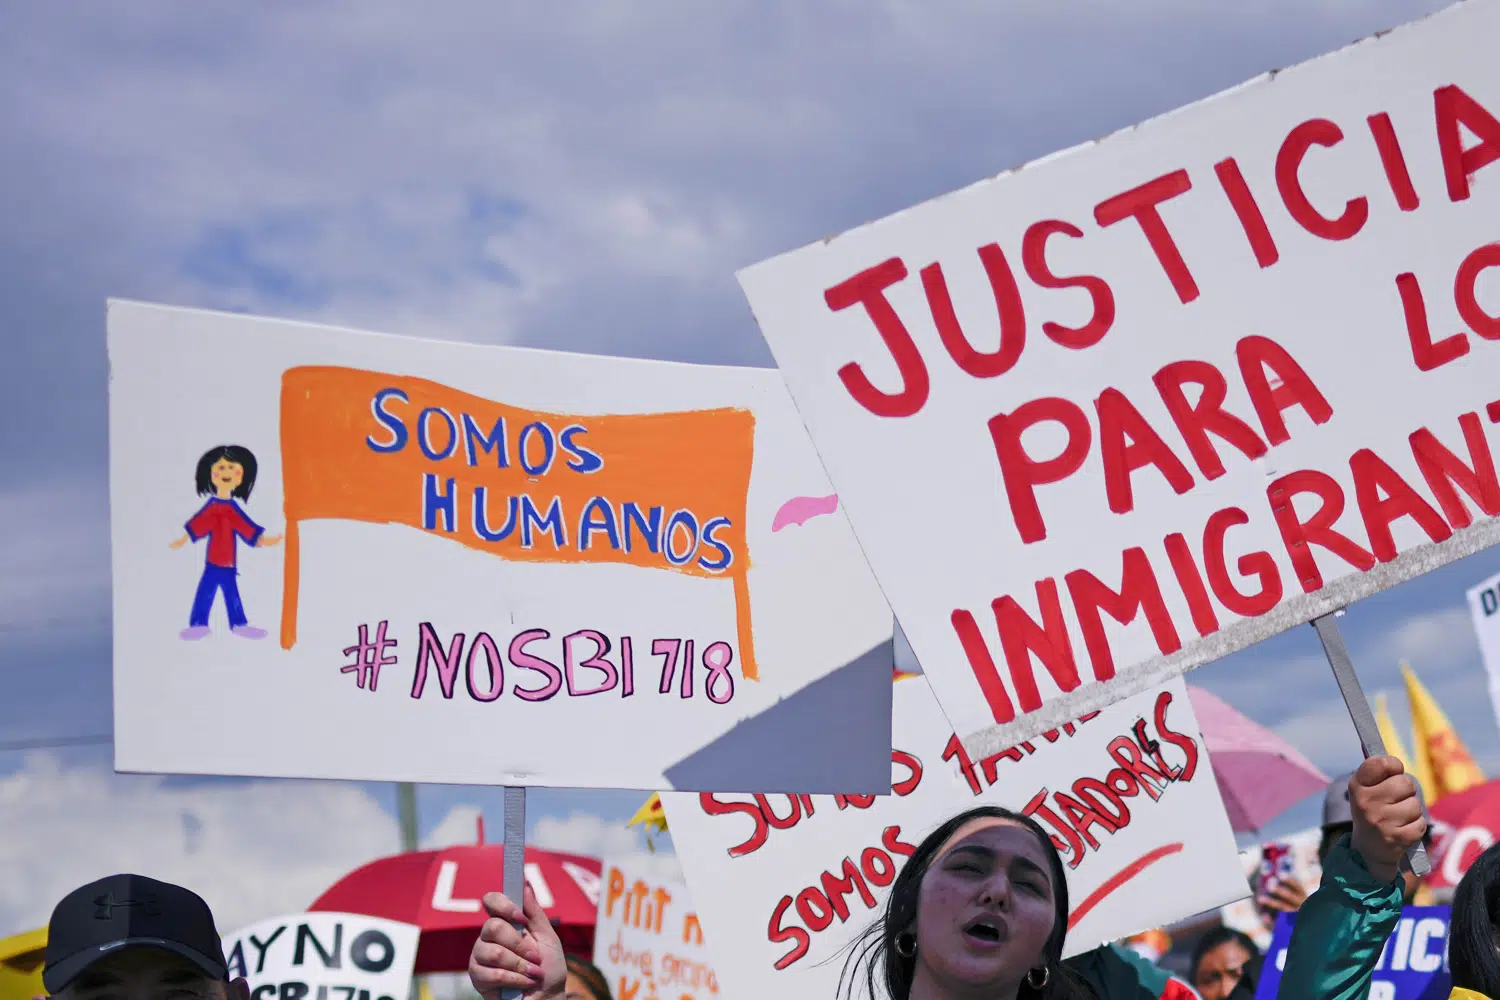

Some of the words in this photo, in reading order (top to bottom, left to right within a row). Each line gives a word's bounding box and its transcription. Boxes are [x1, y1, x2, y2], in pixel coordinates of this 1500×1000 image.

[365, 387, 605, 477] SOMOS
[987, 334, 1334, 546] PARA
[420, 471, 734, 574] HUMANOS
[1020, 690, 1199, 871] JADORES
[226, 925, 289, 979] AY
[292, 922, 396, 973] NO
